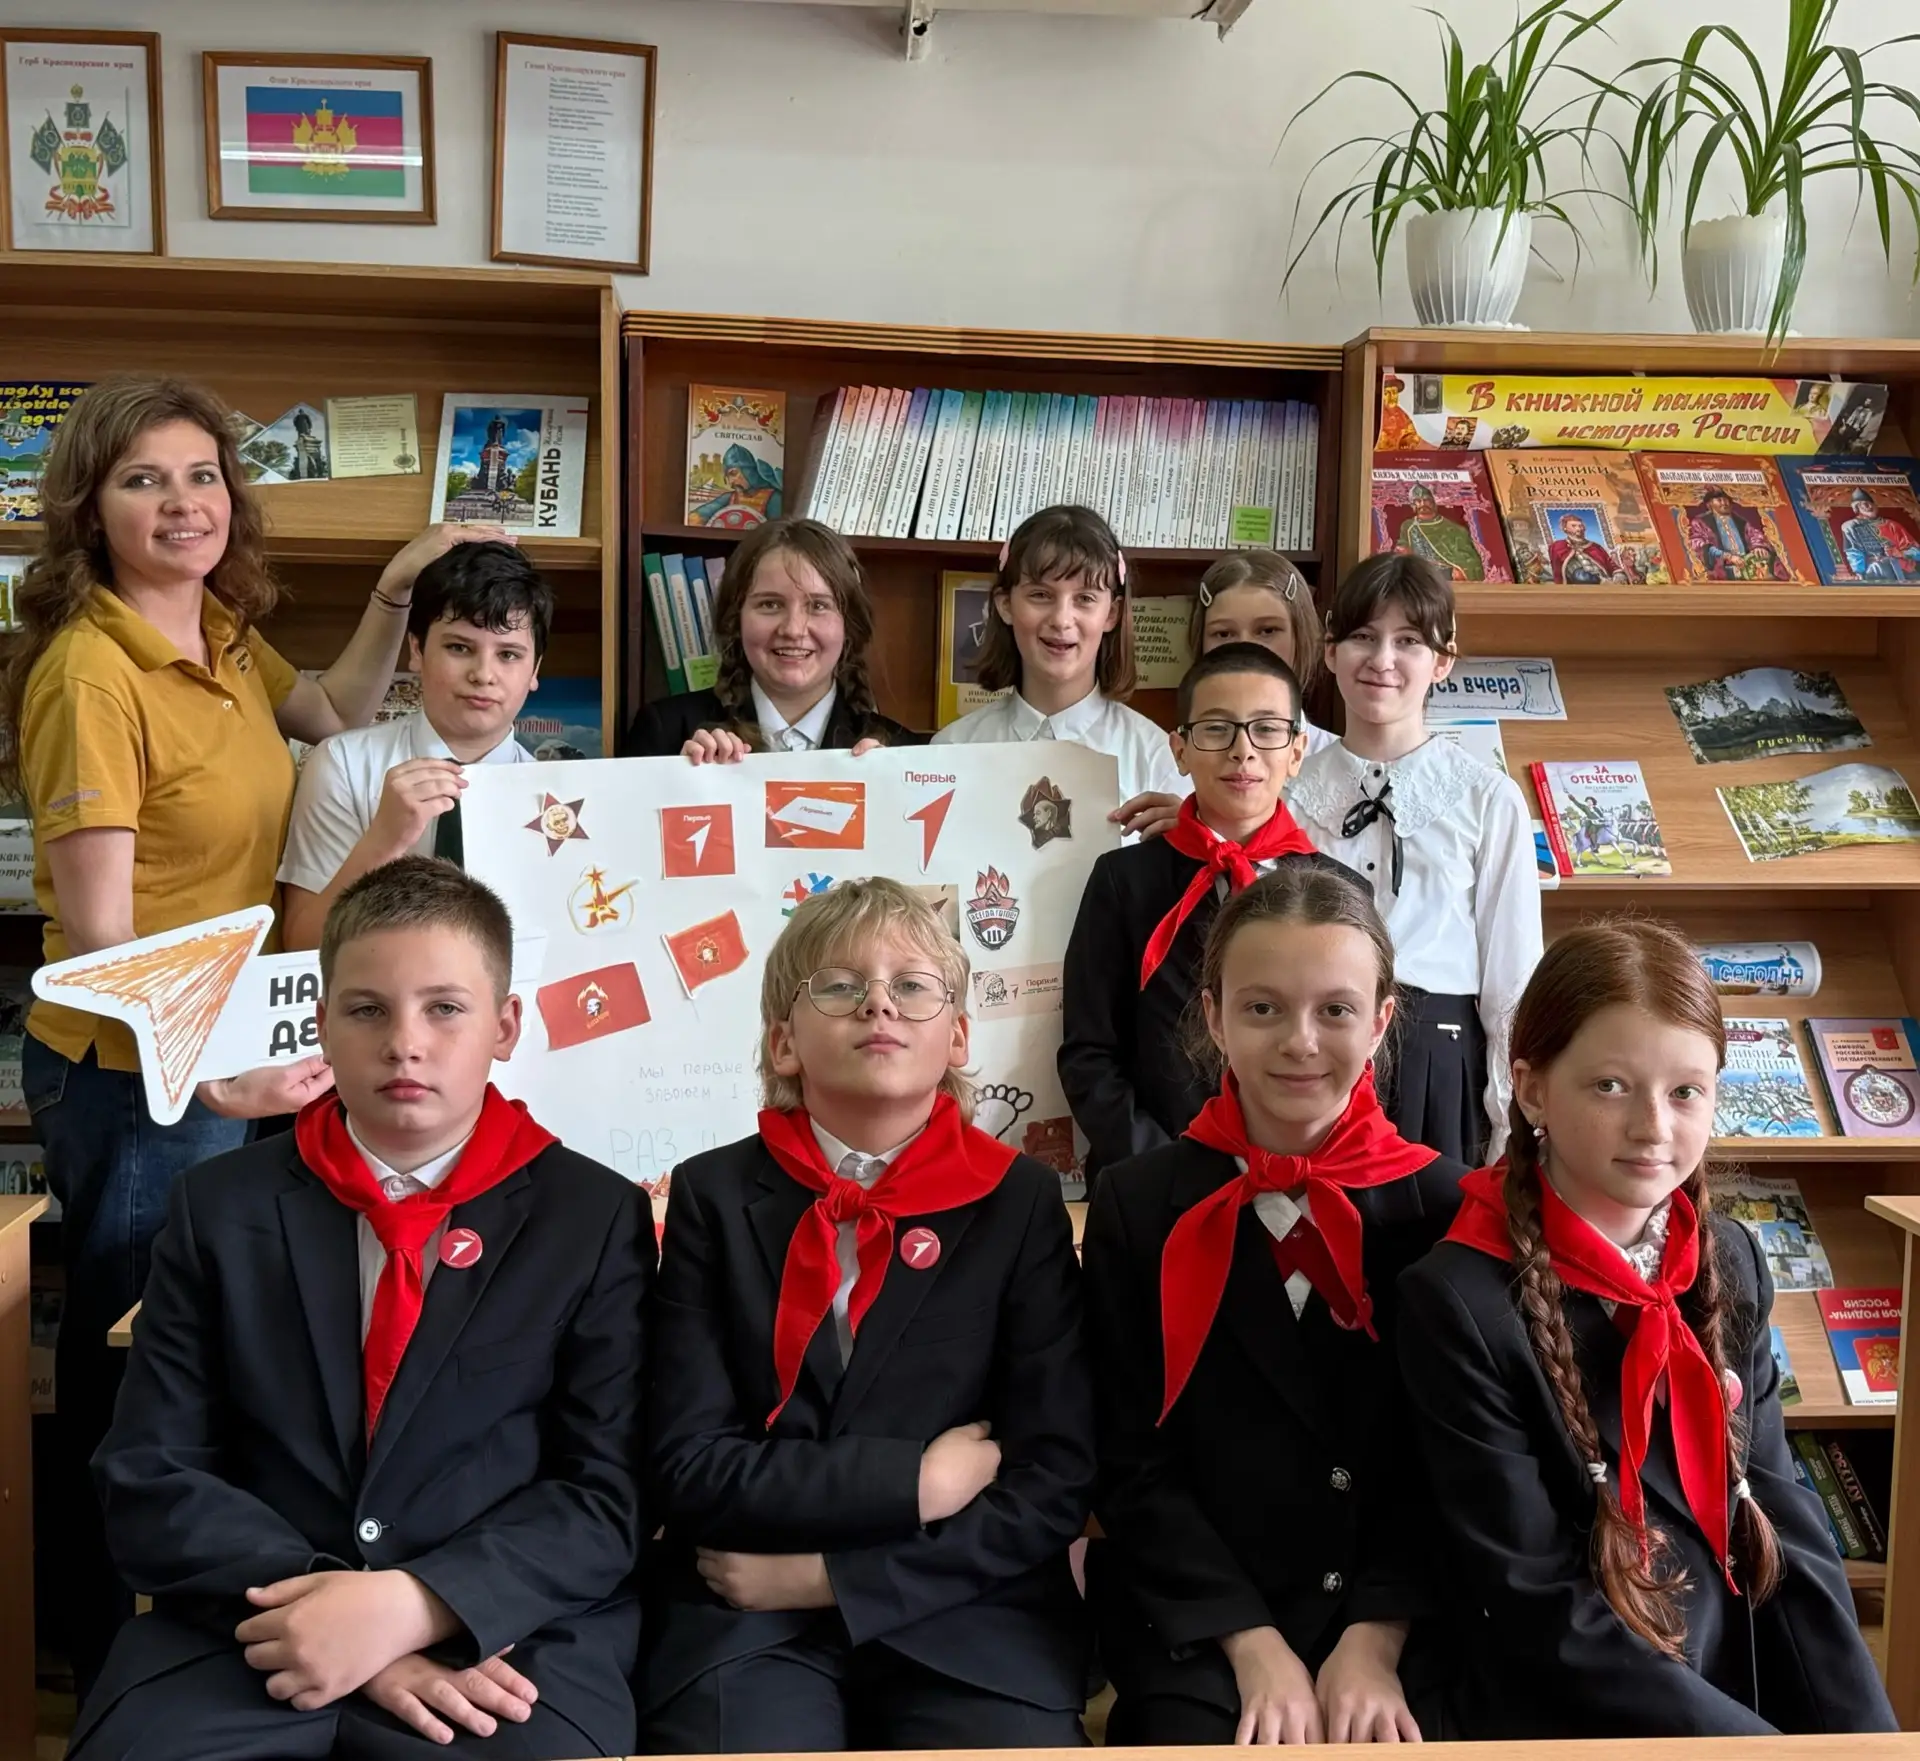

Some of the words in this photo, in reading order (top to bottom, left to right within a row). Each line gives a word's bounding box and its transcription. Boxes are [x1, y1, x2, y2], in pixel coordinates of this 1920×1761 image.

[0, 398, 71, 410] ордост
[1467, 381, 1496, 412] В
[1505, 386, 1642, 413] книжной
[1652, 390, 1771, 412] памяти
[714, 431, 763, 442] СВЯТОСЛАВ
[1557, 423, 1681, 447] история
[1692, 413, 1801, 446] России
[931, 458, 944, 497] РУССКИЙ
[952, 458, 965, 497] РУССКИЙ
[1537, 477, 1587, 486] ЗЕМЛИ
[538, 448, 562, 527] КУБАНЬ
[1463, 676, 1521, 700] вчера
[1756, 736, 1793, 749] Русь
[1796, 734, 1823, 744] Моя
[904, 771, 957, 786] Первые
[1570, 774, 1638, 784] ОТЕЧЕСТВО!
[1593, 765, 1609, 774] ЗА
[1720, 964, 1804, 987] сегодня
[608, 1127, 678, 1171] РАЗ
[1843, 1298, 1890, 1309] РОССИЯ
